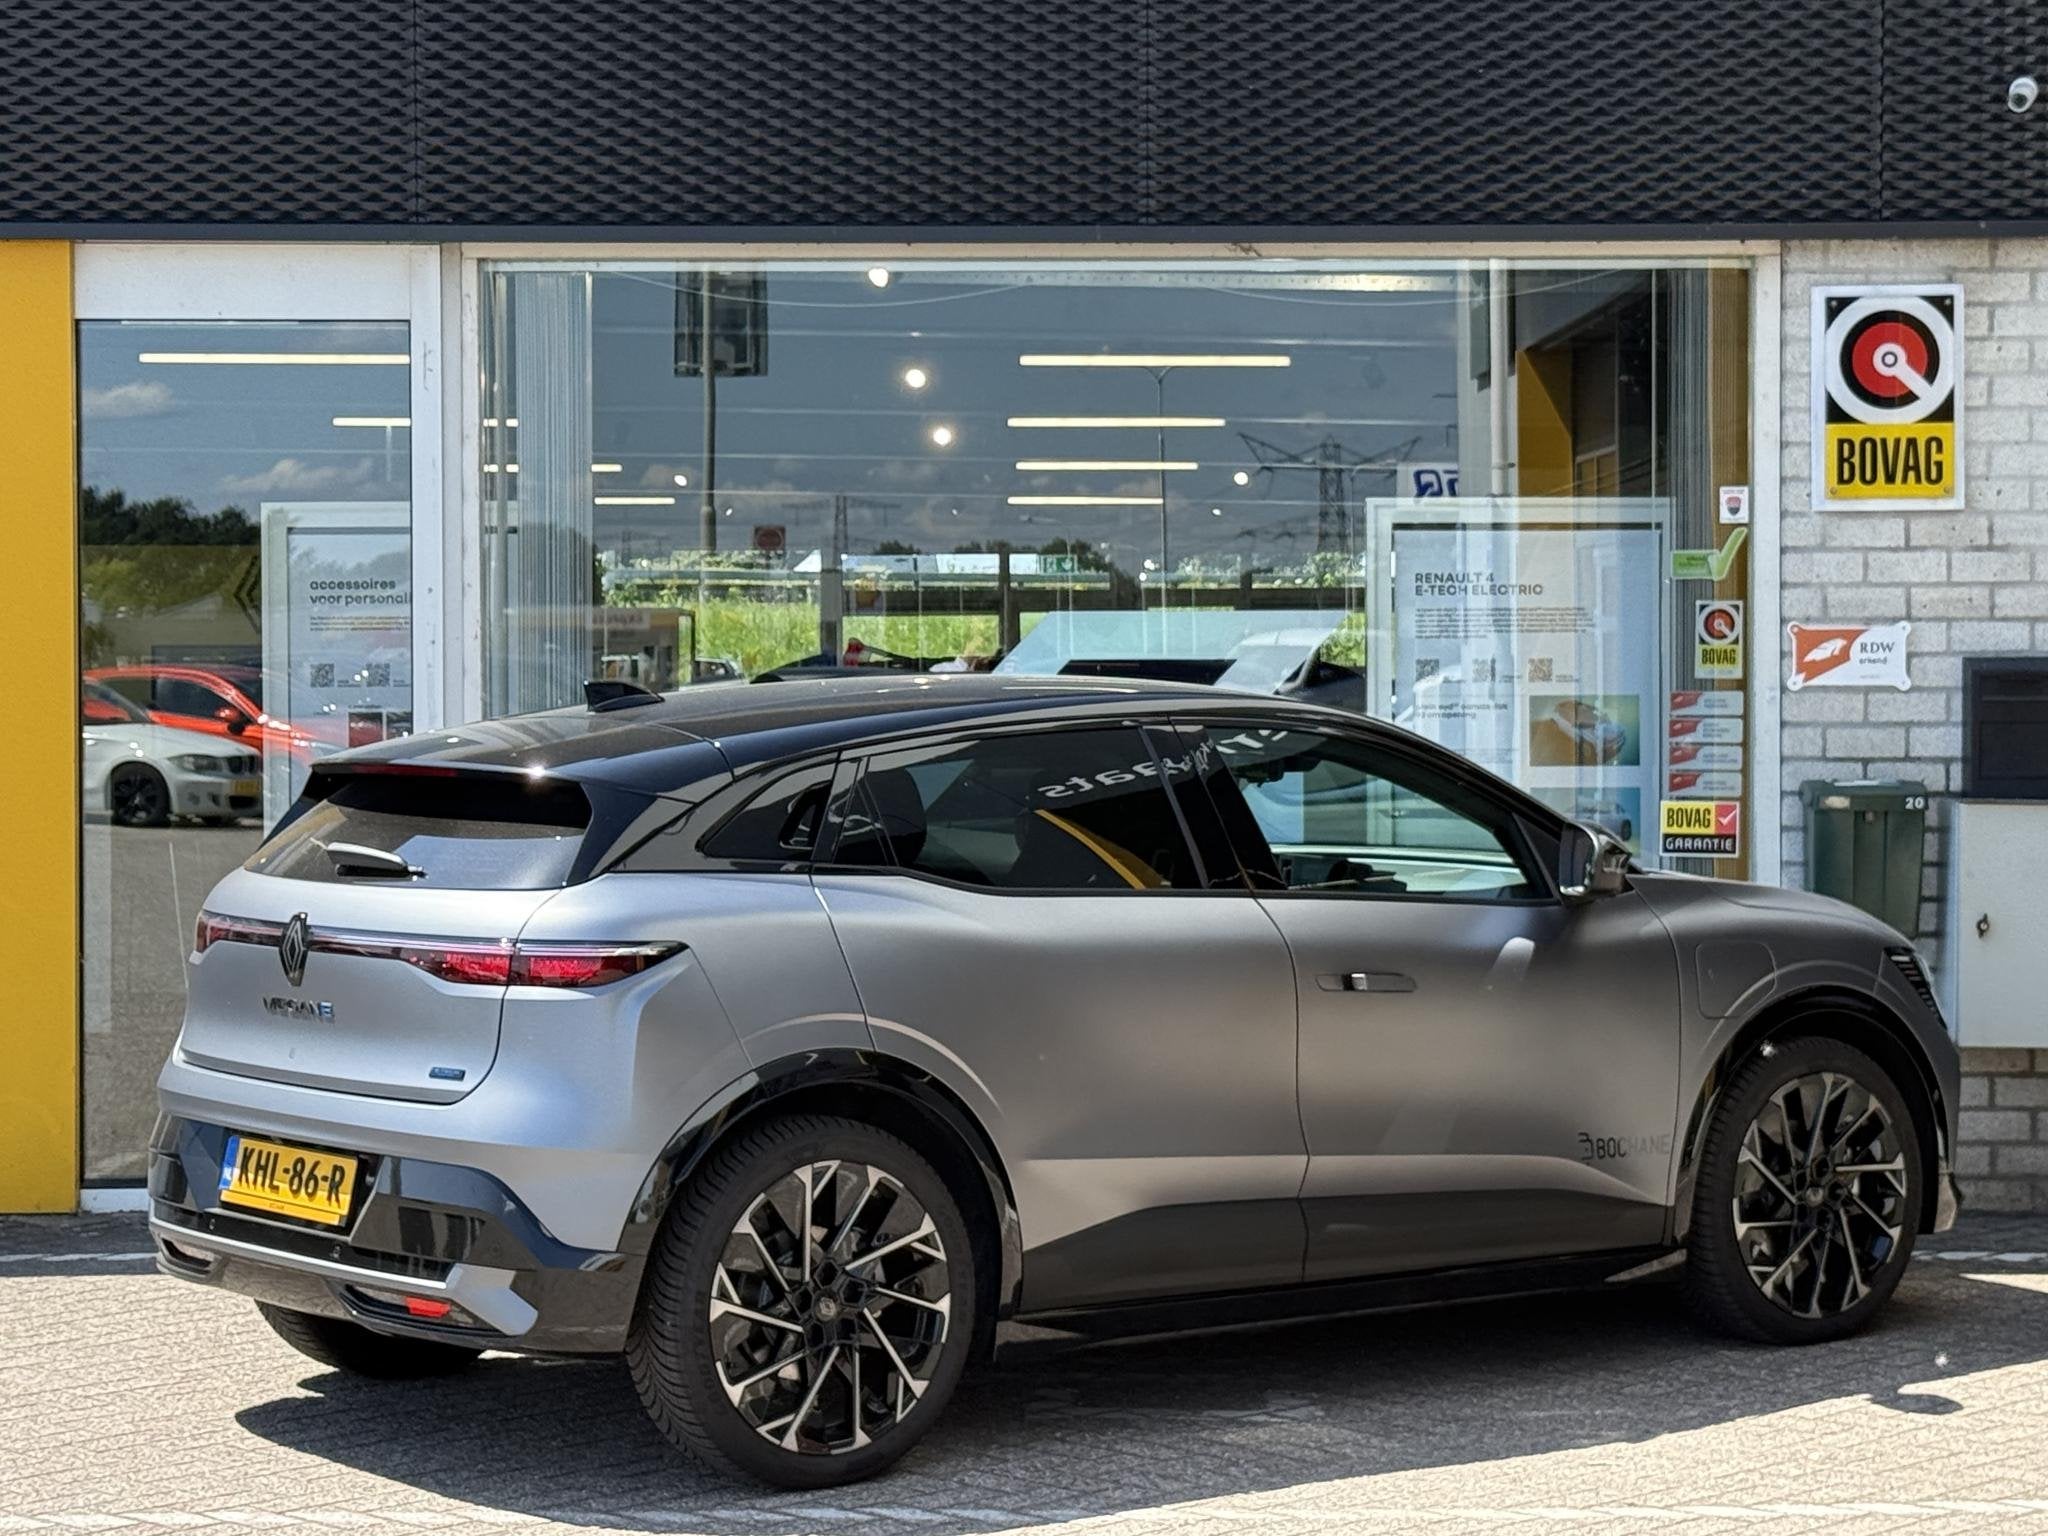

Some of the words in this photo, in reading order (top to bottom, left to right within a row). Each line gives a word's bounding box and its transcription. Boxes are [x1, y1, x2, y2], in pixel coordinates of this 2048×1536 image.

[1836, 436, 1944, 486] BOVAG
[310, 578, 396, 590] accessoires
[1415, 573, 1480, 584] RENAULT
[1486, 573, 1495, 583] 4
[1415, 584, 1467, 596] E-TECH
[1472, 584, 1543, 596] ELECTRIC
[310, 594, 341, 605] voor
[1860, 641, 1896, 654] RDW
[1702, 647, 1736, 665] BOVAG
[1905, 796, 1924, 810] 20
[1666, 807, 1712, 828] BOVAG
[1665, 837, 1733, 851] GARANTIE
[239, 1146, 346, 1209] KHL-86-R
